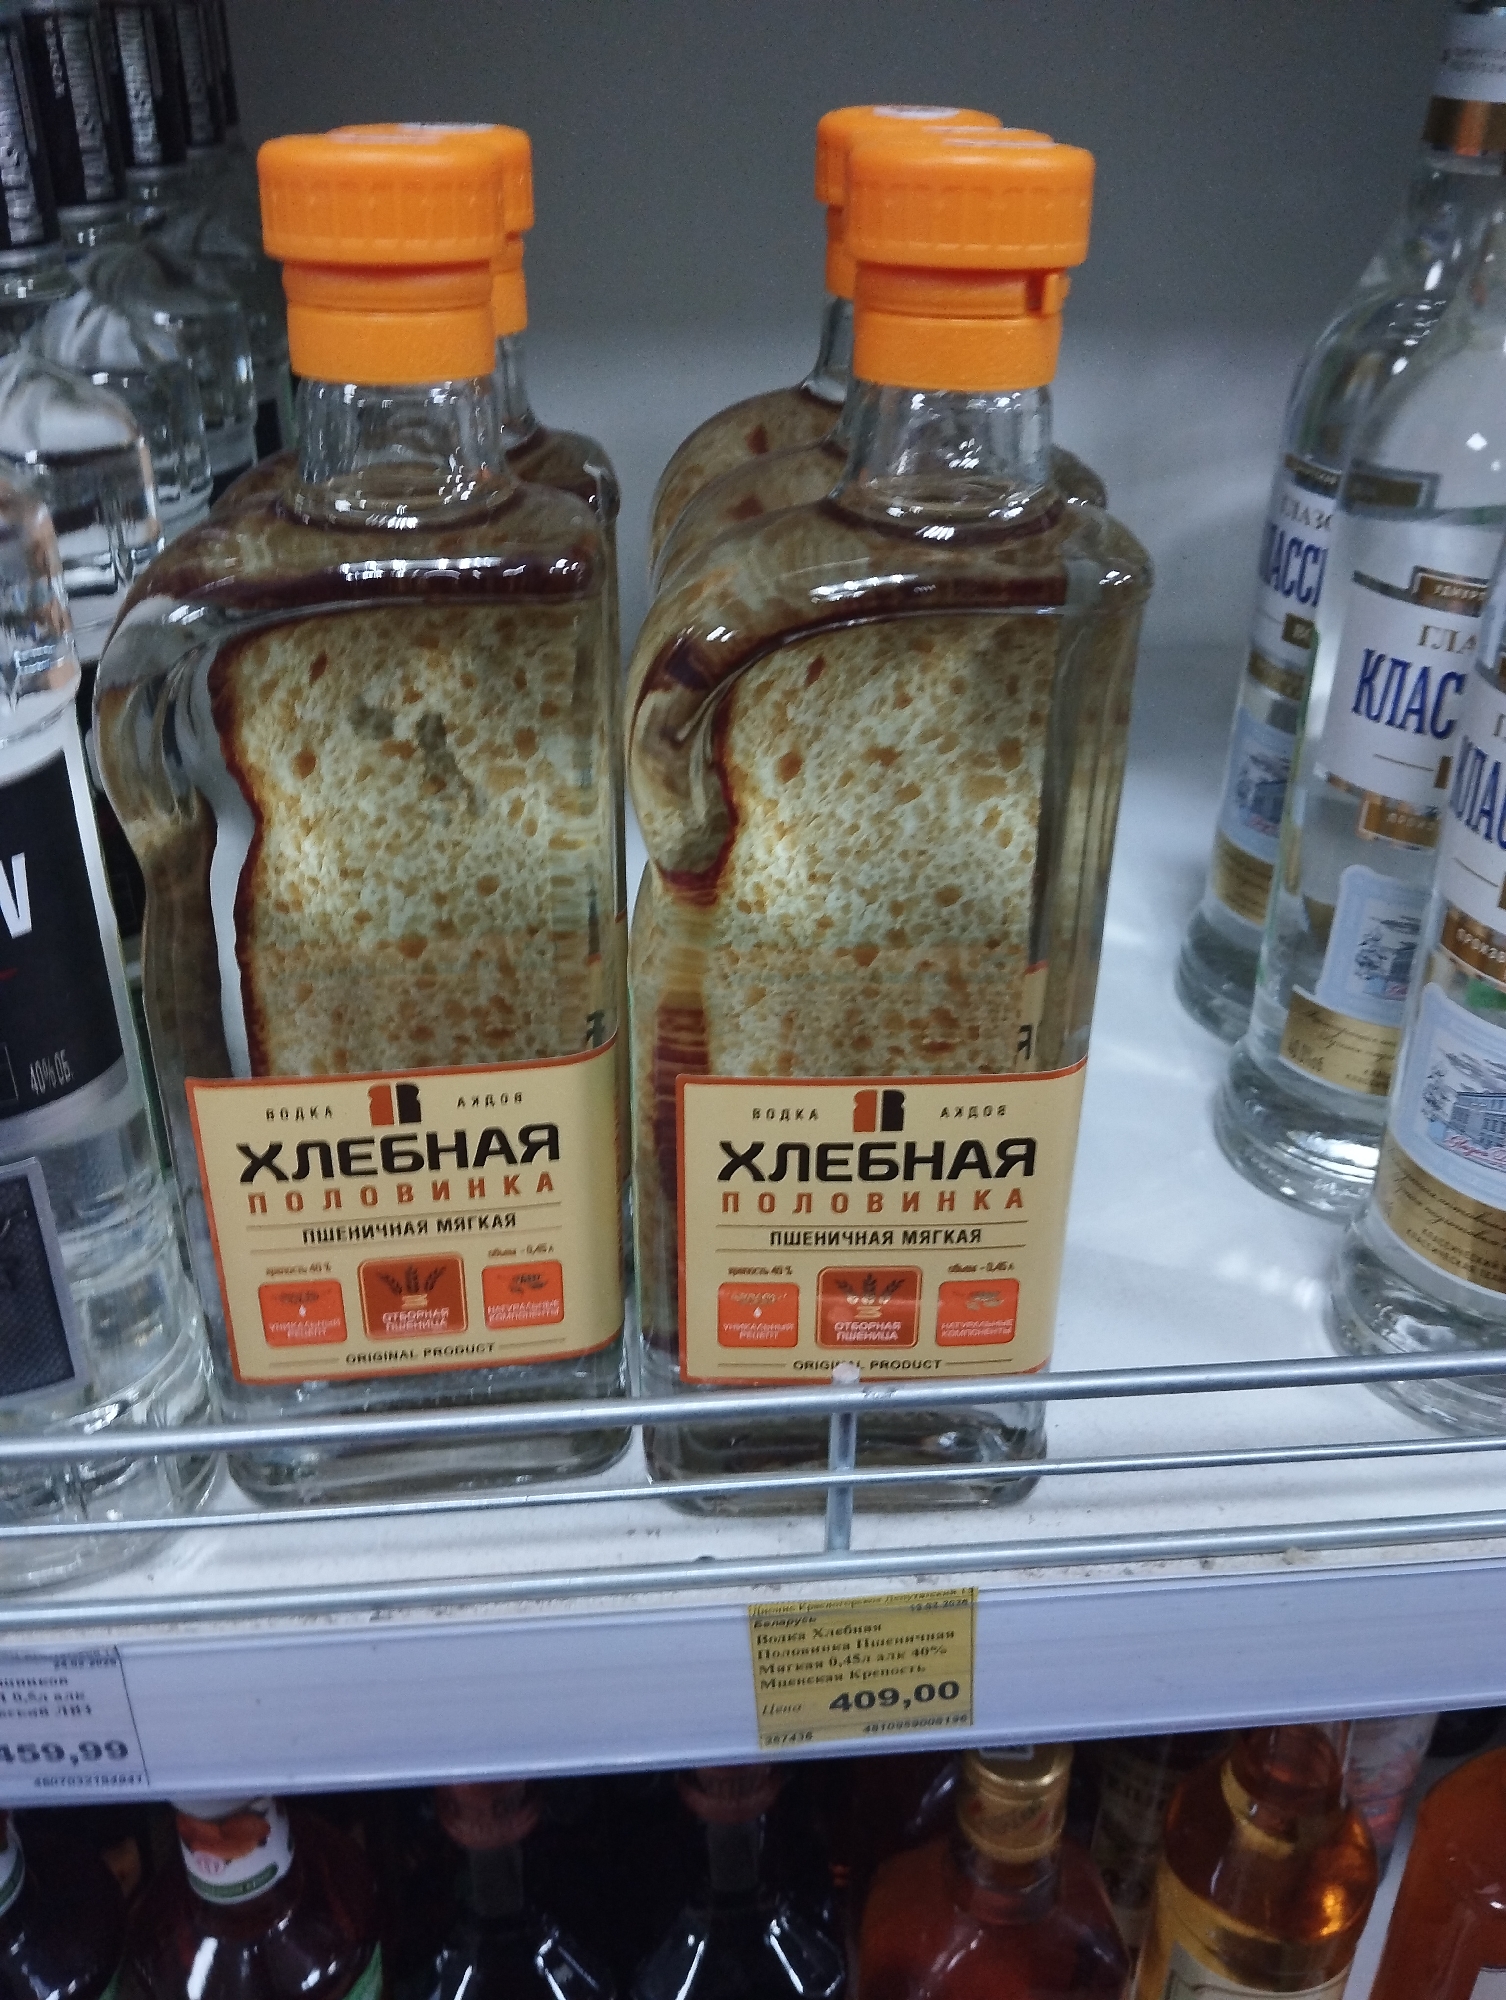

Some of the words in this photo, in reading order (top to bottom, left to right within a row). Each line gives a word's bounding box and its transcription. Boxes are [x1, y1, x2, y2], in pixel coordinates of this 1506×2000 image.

[266, 1105, 333, 1121] ВОДКА
[752, 1107, 819, 1122] ВОДКА
[236, 1122, 560, 1183] ХЛЕБНАЯ
[717, 1137, 1037, 1182] ХЛЕБНАЯ
[248, 1171, 553, 1214] ПОЛОВИНКА
[721, 1187, 1024, 1214] ПОЛОВИНКА
[302, 1219, 428, 1244] ПШЕНИЧНАЯ
[437, 1212, 517, 1234] МЯГКАЯ
[769, 1229, 894, 1247] ПШЕНИЧНАЯ
[902, 1228, 982, 1245] МЯГКАЯ
[835, 1320, 902, 1332] ОТБОРНАЯ
[836, 1330, 898, 1342] ПШЕНИЦА
[346, 1349, 418, 1365] ORIGINAL
[423, 1342, 496, 1358] PRODUCT
[869, 1359, 942, 1370] PRODUCT
[757, 1632, 806, 1646] Водка
[813, 1624, 882, 1639] Хлебная
[758, 1643, 850, 1660] Половинка
[856, 1630, 955, 1650] Пшеничная
[760, 1660, 823, 1675] Мягкая
[877, 1652, 905, 1662] алк
[912, 1645, 948, 1658] 40%
[850, 1664, 926, 1680] Крепость
[829, 1680, 960, 1712] 409,00
